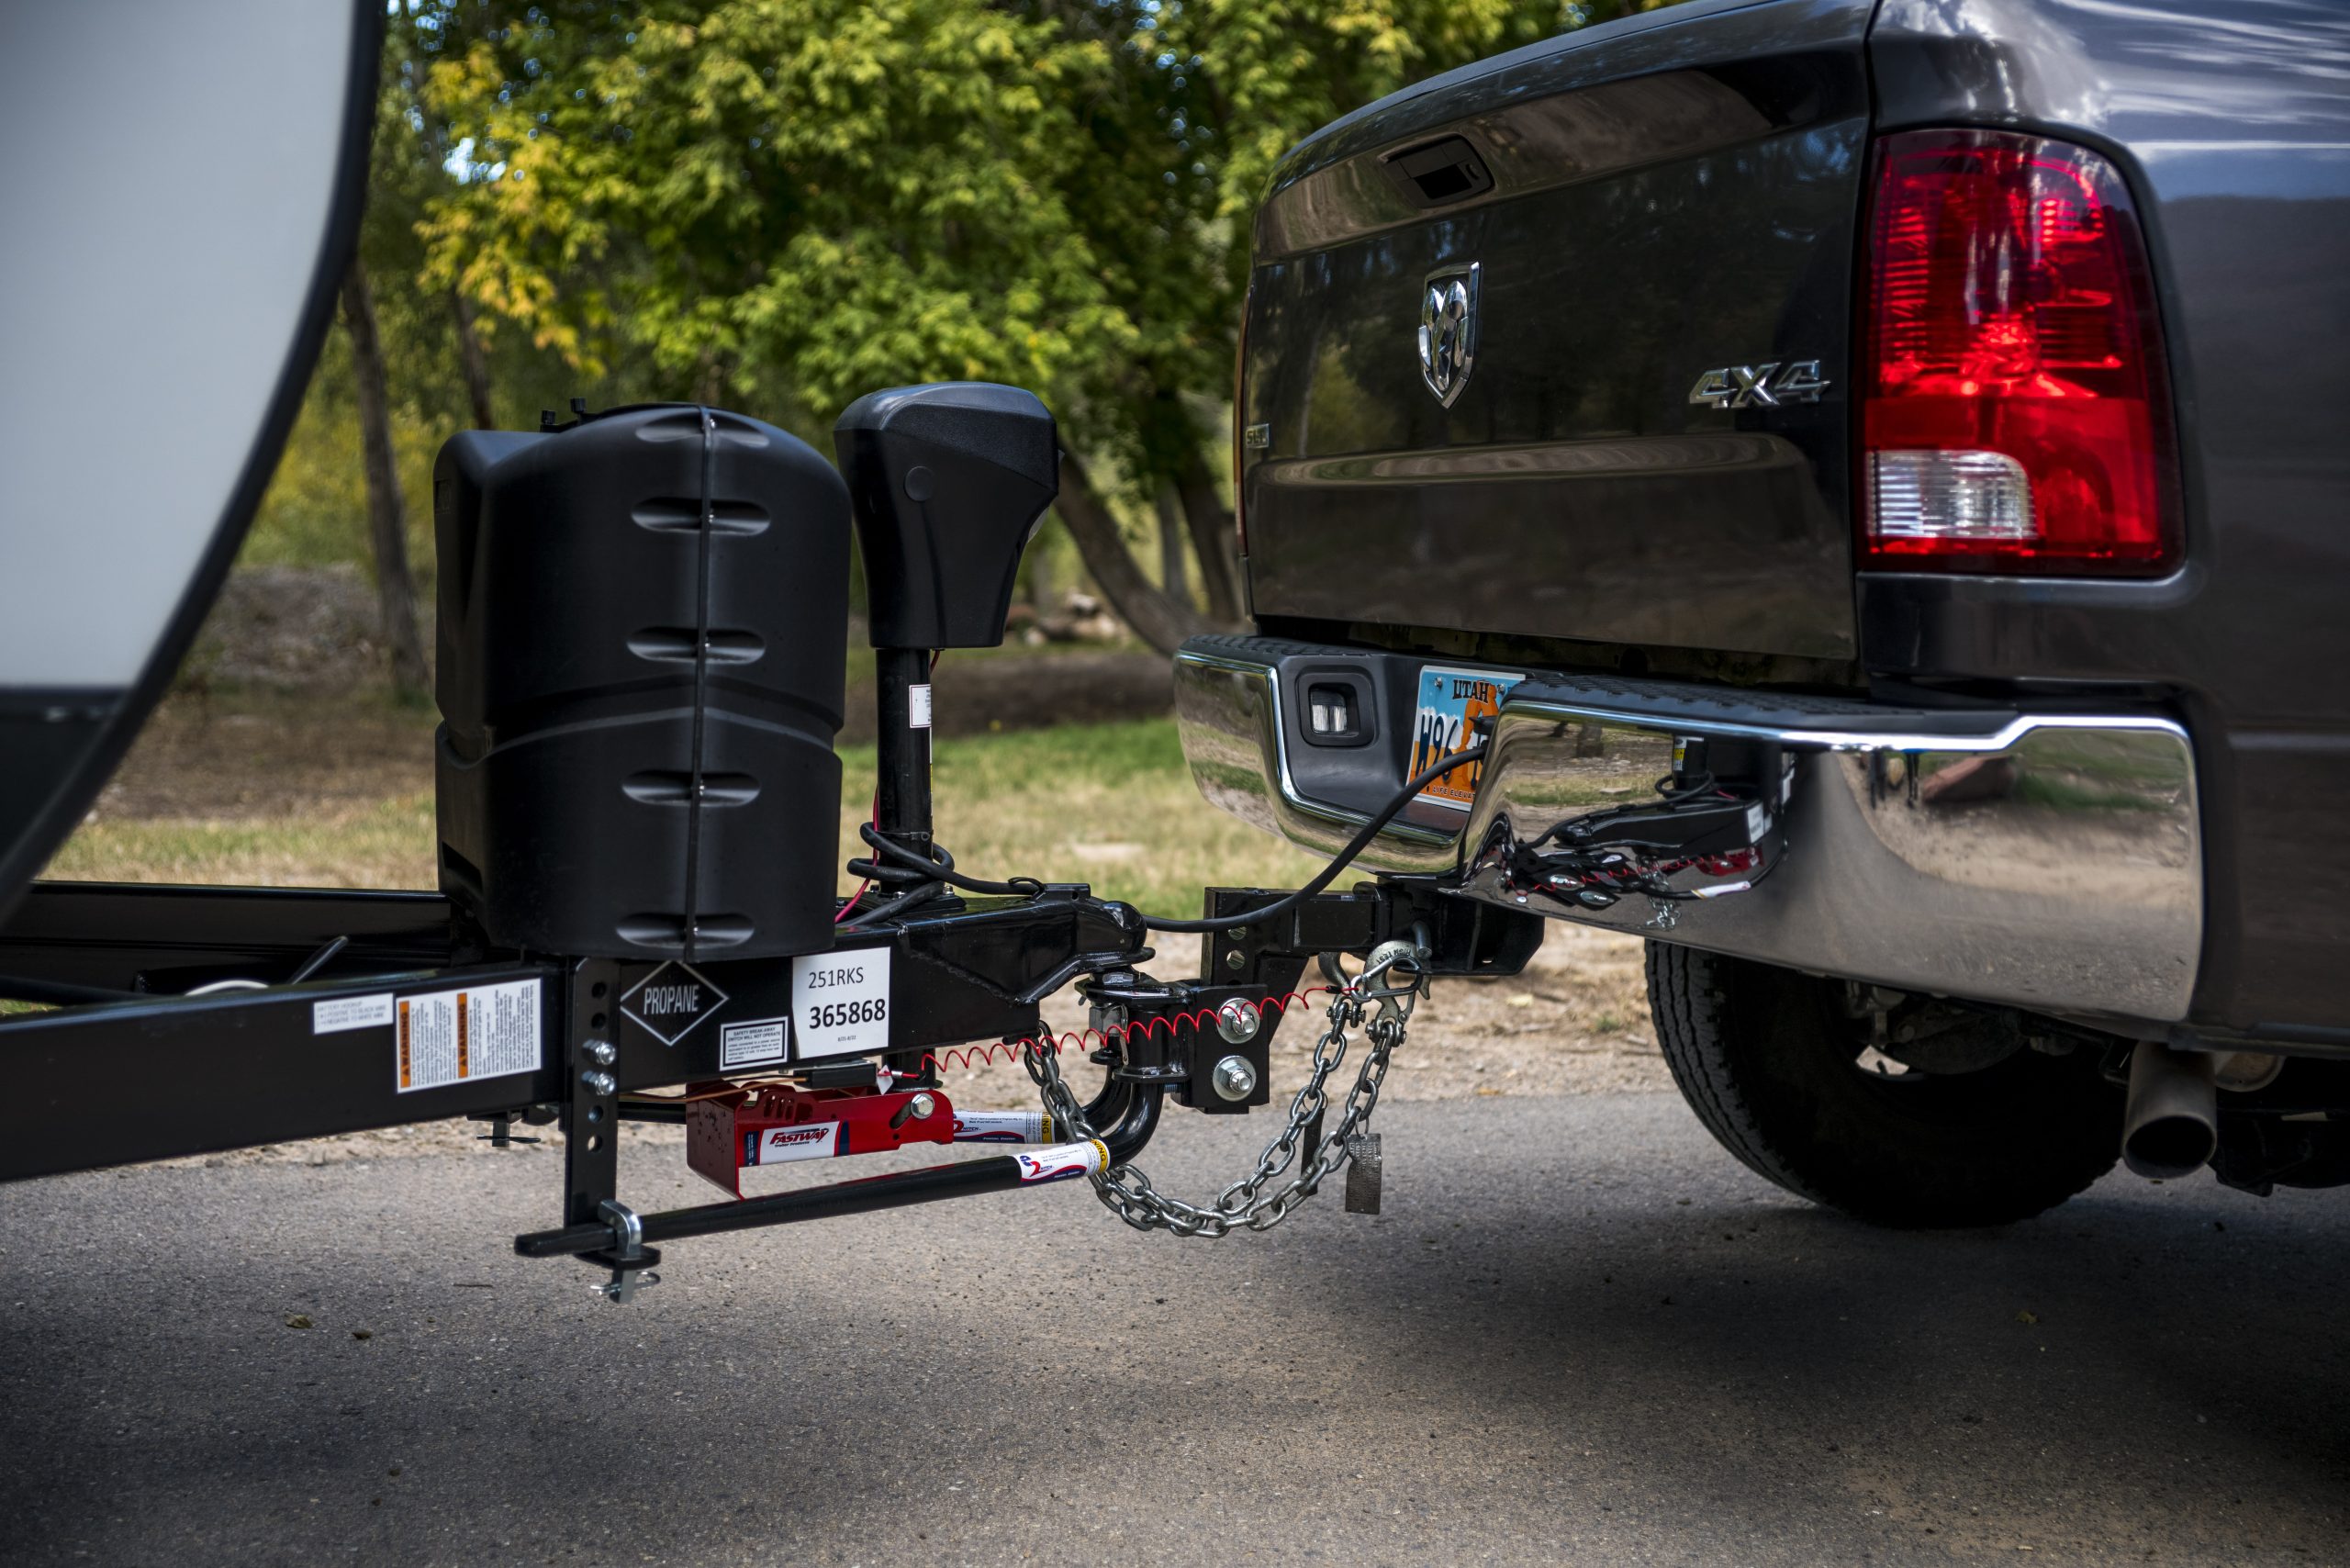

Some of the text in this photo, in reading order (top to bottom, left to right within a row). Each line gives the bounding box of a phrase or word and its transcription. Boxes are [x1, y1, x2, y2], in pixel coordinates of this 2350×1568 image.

[1689, 359, 1831, 409] 4X4
[1452, 678, 1491, 704] UTAH
[1432, 785, 1476, 800] LIFE ELEVAT
[808, 967, 864, 989] 251RKS
[643, 984, 699, 1015] PROPANE
[809, 998, 886, 1029] 365868
[769, 1127, 829, 1145] FASTWAY
